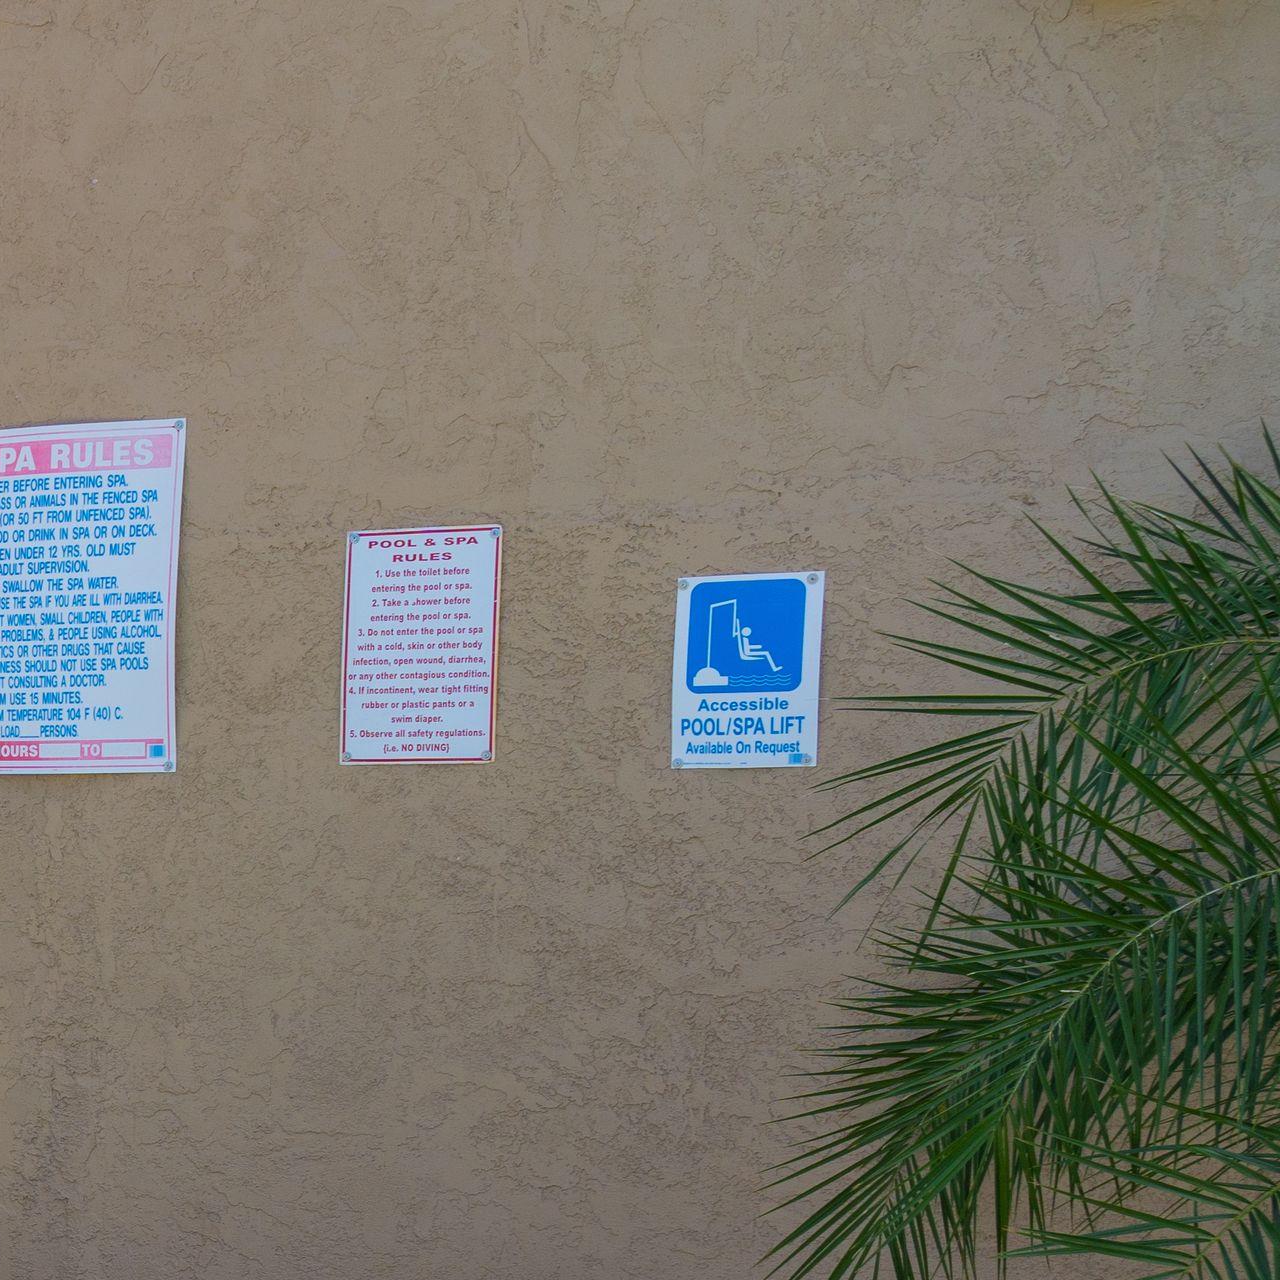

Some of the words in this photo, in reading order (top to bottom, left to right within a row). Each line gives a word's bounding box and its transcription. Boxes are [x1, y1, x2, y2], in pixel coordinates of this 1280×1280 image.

[50, 438, 155, 470] RULES
[13, 477, 50, 492] BEFORE
[54, 474, 103, 490] ENTERING
[15, 495, 26, 509] OR
[29, 493, 66, 508] ANIMALS
[69, 493, 78, 505] IN
[81, 492, 99, 505] THE
[102, 490, 138, 504] FENCED
[141, 489, 158, 503] SPA
[18, 511, 29, 525] 50
[32, 511, 43, 523] FT
[46, 509, 72, 523] FROM
[75, 507, 125, 522] UNFENCED
[12, 529, 25, 543] OR
[28, 528, 55, 542] DRINK
[59, 527, 68, 539] IN
[72, 526, 90, 540] SPA
[93, 525, 107, 539] OR
[111, 525, 125, 538] ON
[368, 539, 416, 549] POOL
[424, 538, 436, 546] &
[444, 536, 478, 545] SPA
[14, 546, 44, 560] UNDER
[48, 545, 57, 558] 12
[85, 543, 105, 557] OLD
[109, 541, 136, 556] MUST
[392, 552, 452, 562] RULES
[375, 570, 382, 578] 1.
[385, 569, 400, 577] Use
[419, 567, 440, 576] toilet
[443, 566, 470, 575] before
[2, 579, 43, 593] SWALLOW
[47, 578, 64, 591] THE
[67, 577, 84, 591] SPA
[371, 583, 405, 593] entering
[407, 583, 421, 591] the
[423, 582, 441, 592] pool
[454, 583, 472, 591] spa.
[371, 599, 379, 607] 2.
[381, 598, 401, 606] Take
[443, 596, 470, 605] before
[40, 612, 65, 625] SMALL
[111, 609, 140, 623] PEOPLE
[143, 608, 163, 621] WITH
[370, 613, 404, 623] entering
[406, 612, 420, 620] the
[422, 611, 440, 622] pool
[453, 612, 471, 621] spa.
[48, 628, 54, 641] &
[58, 627, 88, 640] PEOPLE
[91, 625, 117, 639] USING
[17, 645, 29, 658] OR
[32, 644, 58, 657] OTHER
[61, 642, 90, 656] DRUGS
[93, 642, 114, 655] THAT
[116, 641, 145, 655] CAUSE
[24, 659, 57, 673] SHOULD
[60, 658, 77, 672] NOT
[80, 658, 97, 672] USE
[100, 657, 117, 671] SPA
[119, 656, 148, 670] POOLS
[352, 657, 391, 665] infection,
[393, 658, 413, 666] open
[415, 655, 445, 664] wound,
[448, 655, 486, 664] diarrhea,
[8, 674, 58, 688] CONSULTING
[60, 674, 66, 686] A
[359, 673, 373, 681] any
[375, 671, 397, 680] other
[399, 671, 446, 680] contagious
[448, 669, 490, 678] condition.
[9, 692, 26, 705] USE
[29, 692, 39, 705] 15
[697, 696, 789, 712] Accessible
[6, 708, 63, 721] TEMPERATURE
[66, 707, 81, 720] 104
[84, 707, 90, 719] F
[349, 729, 357, 737] 5.
[359, 729, 393, 737] Observe
[395, 729, 405, 737] all
[407, 729, 433, 739] safety
[435, 728, 486, 739] regulations.
[680, 716, 766, 737] POOL/SPA
[770, 715, 806, 735] LIFT
[81, 743, 102, 757] TO
[401, 743, 414, 751] NO
[686, 741, 733, 755] Available
[736, 741, 751, 754] On
[755, 739, 800, 757] Request
